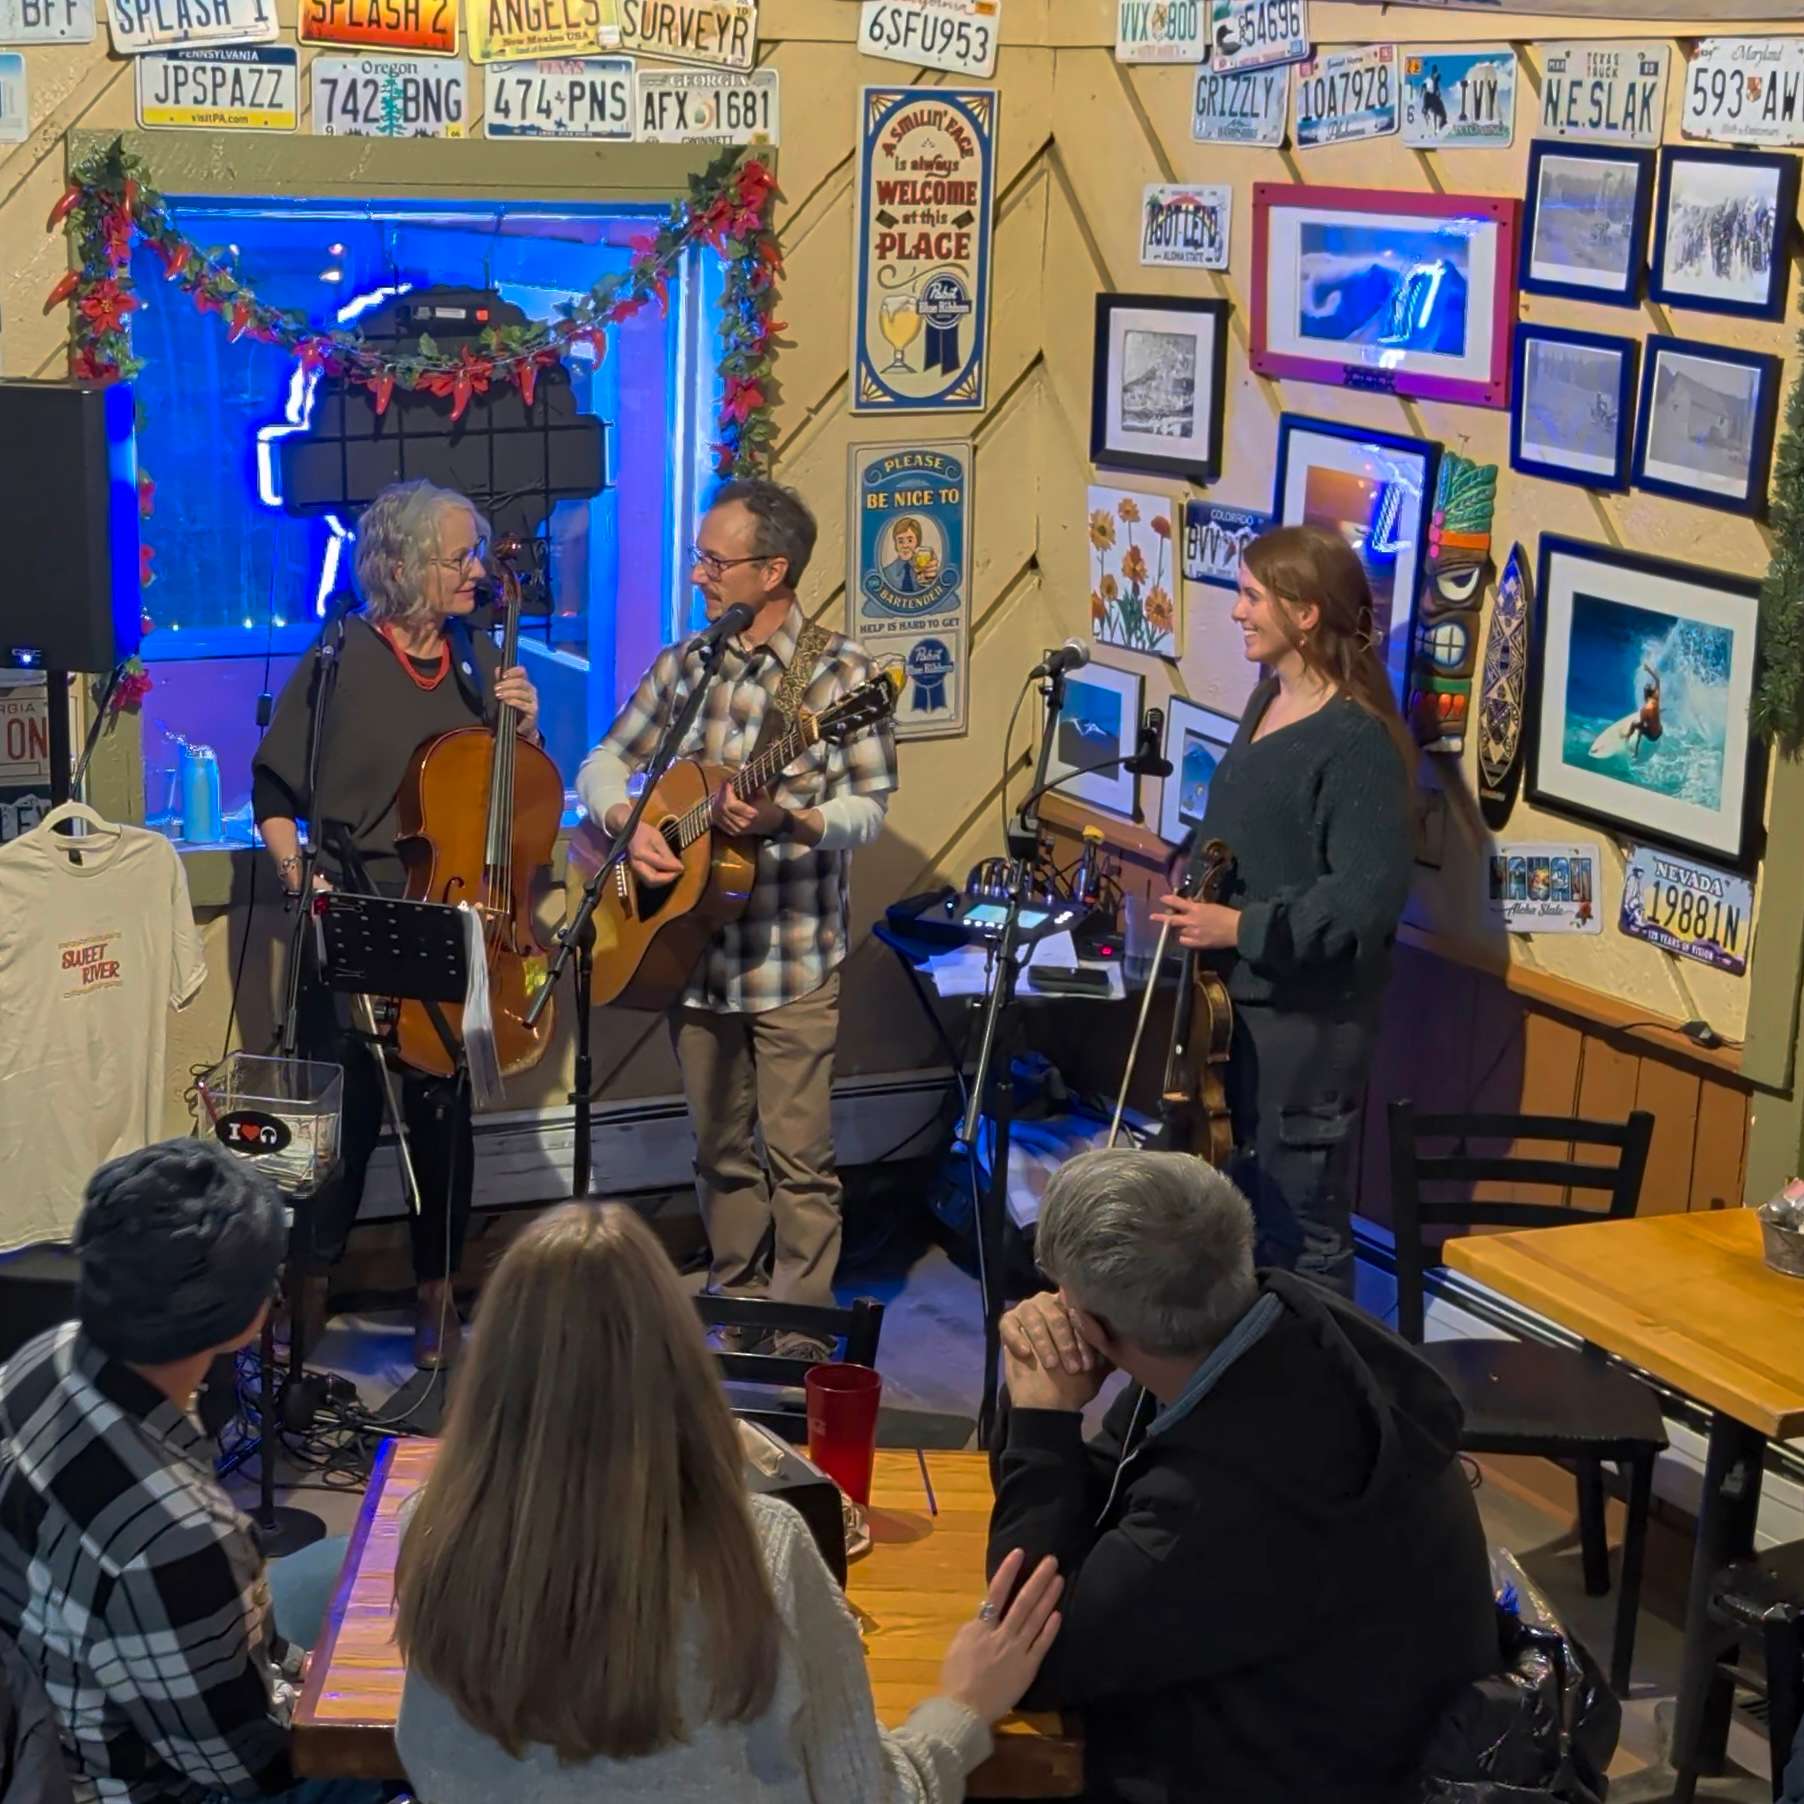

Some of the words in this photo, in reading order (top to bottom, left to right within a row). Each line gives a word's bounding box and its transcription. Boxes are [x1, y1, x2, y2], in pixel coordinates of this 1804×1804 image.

[115, 0, 231, 34] SPLASH
[311, 0, 420, 32] SPLASH
[432, 0, 447, 34] 2
[489, 0, 600, 36] ANGELS
[623, 0, 749, 57] SURVEYR
[869, 5, 989, 63] 6SFU953
[361, 60, 418, 77] Oregon
[1587, 52, 1619, 66] TEXAS
[1587, 65, 1618, 78] TRUCK
[154, 65, 283, 109] JPSPAZZ
[670, 74, 746, 87] GEORGIA
[319, 78, 380, 124] 742
[403, 77, 461, 123] BNG
[494, 78, 552, 120] 474
[569, 80, 626, 121] PNS
[1196, 74, 1274, 119] GRIZZLY
[1459, 80, 1498, 121] IVY
[1692, 67, 1744, 118] 593
[1762, 70, 1804, 122] AW
[192, 114, 249, 124] visitPA.com
[644, 91, 688, 131] AFX
[714, 90, 768, 130] 1681
[882, 143, 897, 158] A
[895, 156, 907, 171] is
[910, 153, 960, 178] always
[876, 181, 978, 206] WELCOME
[902, 210, 918, 225] at
[920, 208, 948, 227] this
[875, 232, 971, 260] PLACE
[884, 455, 945, 473] PLEASE
[866, 493, 889, 509] BE
[894, 489, 934, 507] NICE
[939, 488, 960, 504] TO
[880, 584, 944, 609] BARTENDER
[860, 623, 885, 634] HELP
[887, 622, 897, 632] IS
[899, 620, 926, 631] HARD
[928, 619, 940, 628] TO
[942, 617, 960, 627] GET
[1655, 859, 1724, 898] NEVADA
[1538, 902, 1566, 917] State
[62, 943, 108, 970] SWEET
[83, 960, 120, 984] RIVER
